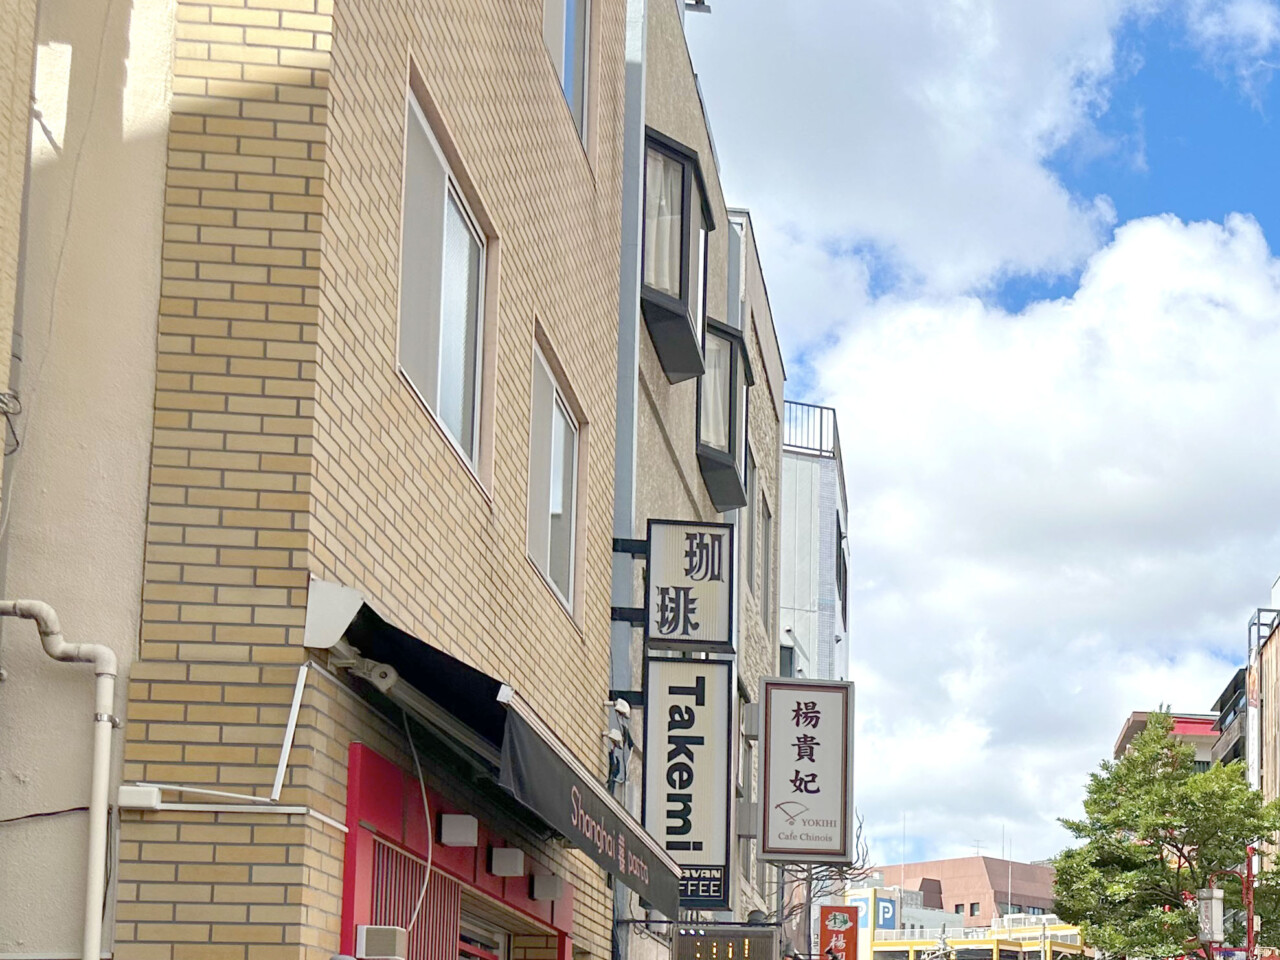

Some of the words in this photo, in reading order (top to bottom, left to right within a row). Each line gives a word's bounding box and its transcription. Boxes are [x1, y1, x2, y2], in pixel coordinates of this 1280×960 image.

[655, 532, 724, 635] 珈琲
[666, 676, 706, 851] Takemi
[789, 701, 821, 795] 楊貴妃
[571, 786, 616, 860] Shanghai
[800, 832, 833, 843] Chinois
[802, 819, 837, 828] YOKIHI
